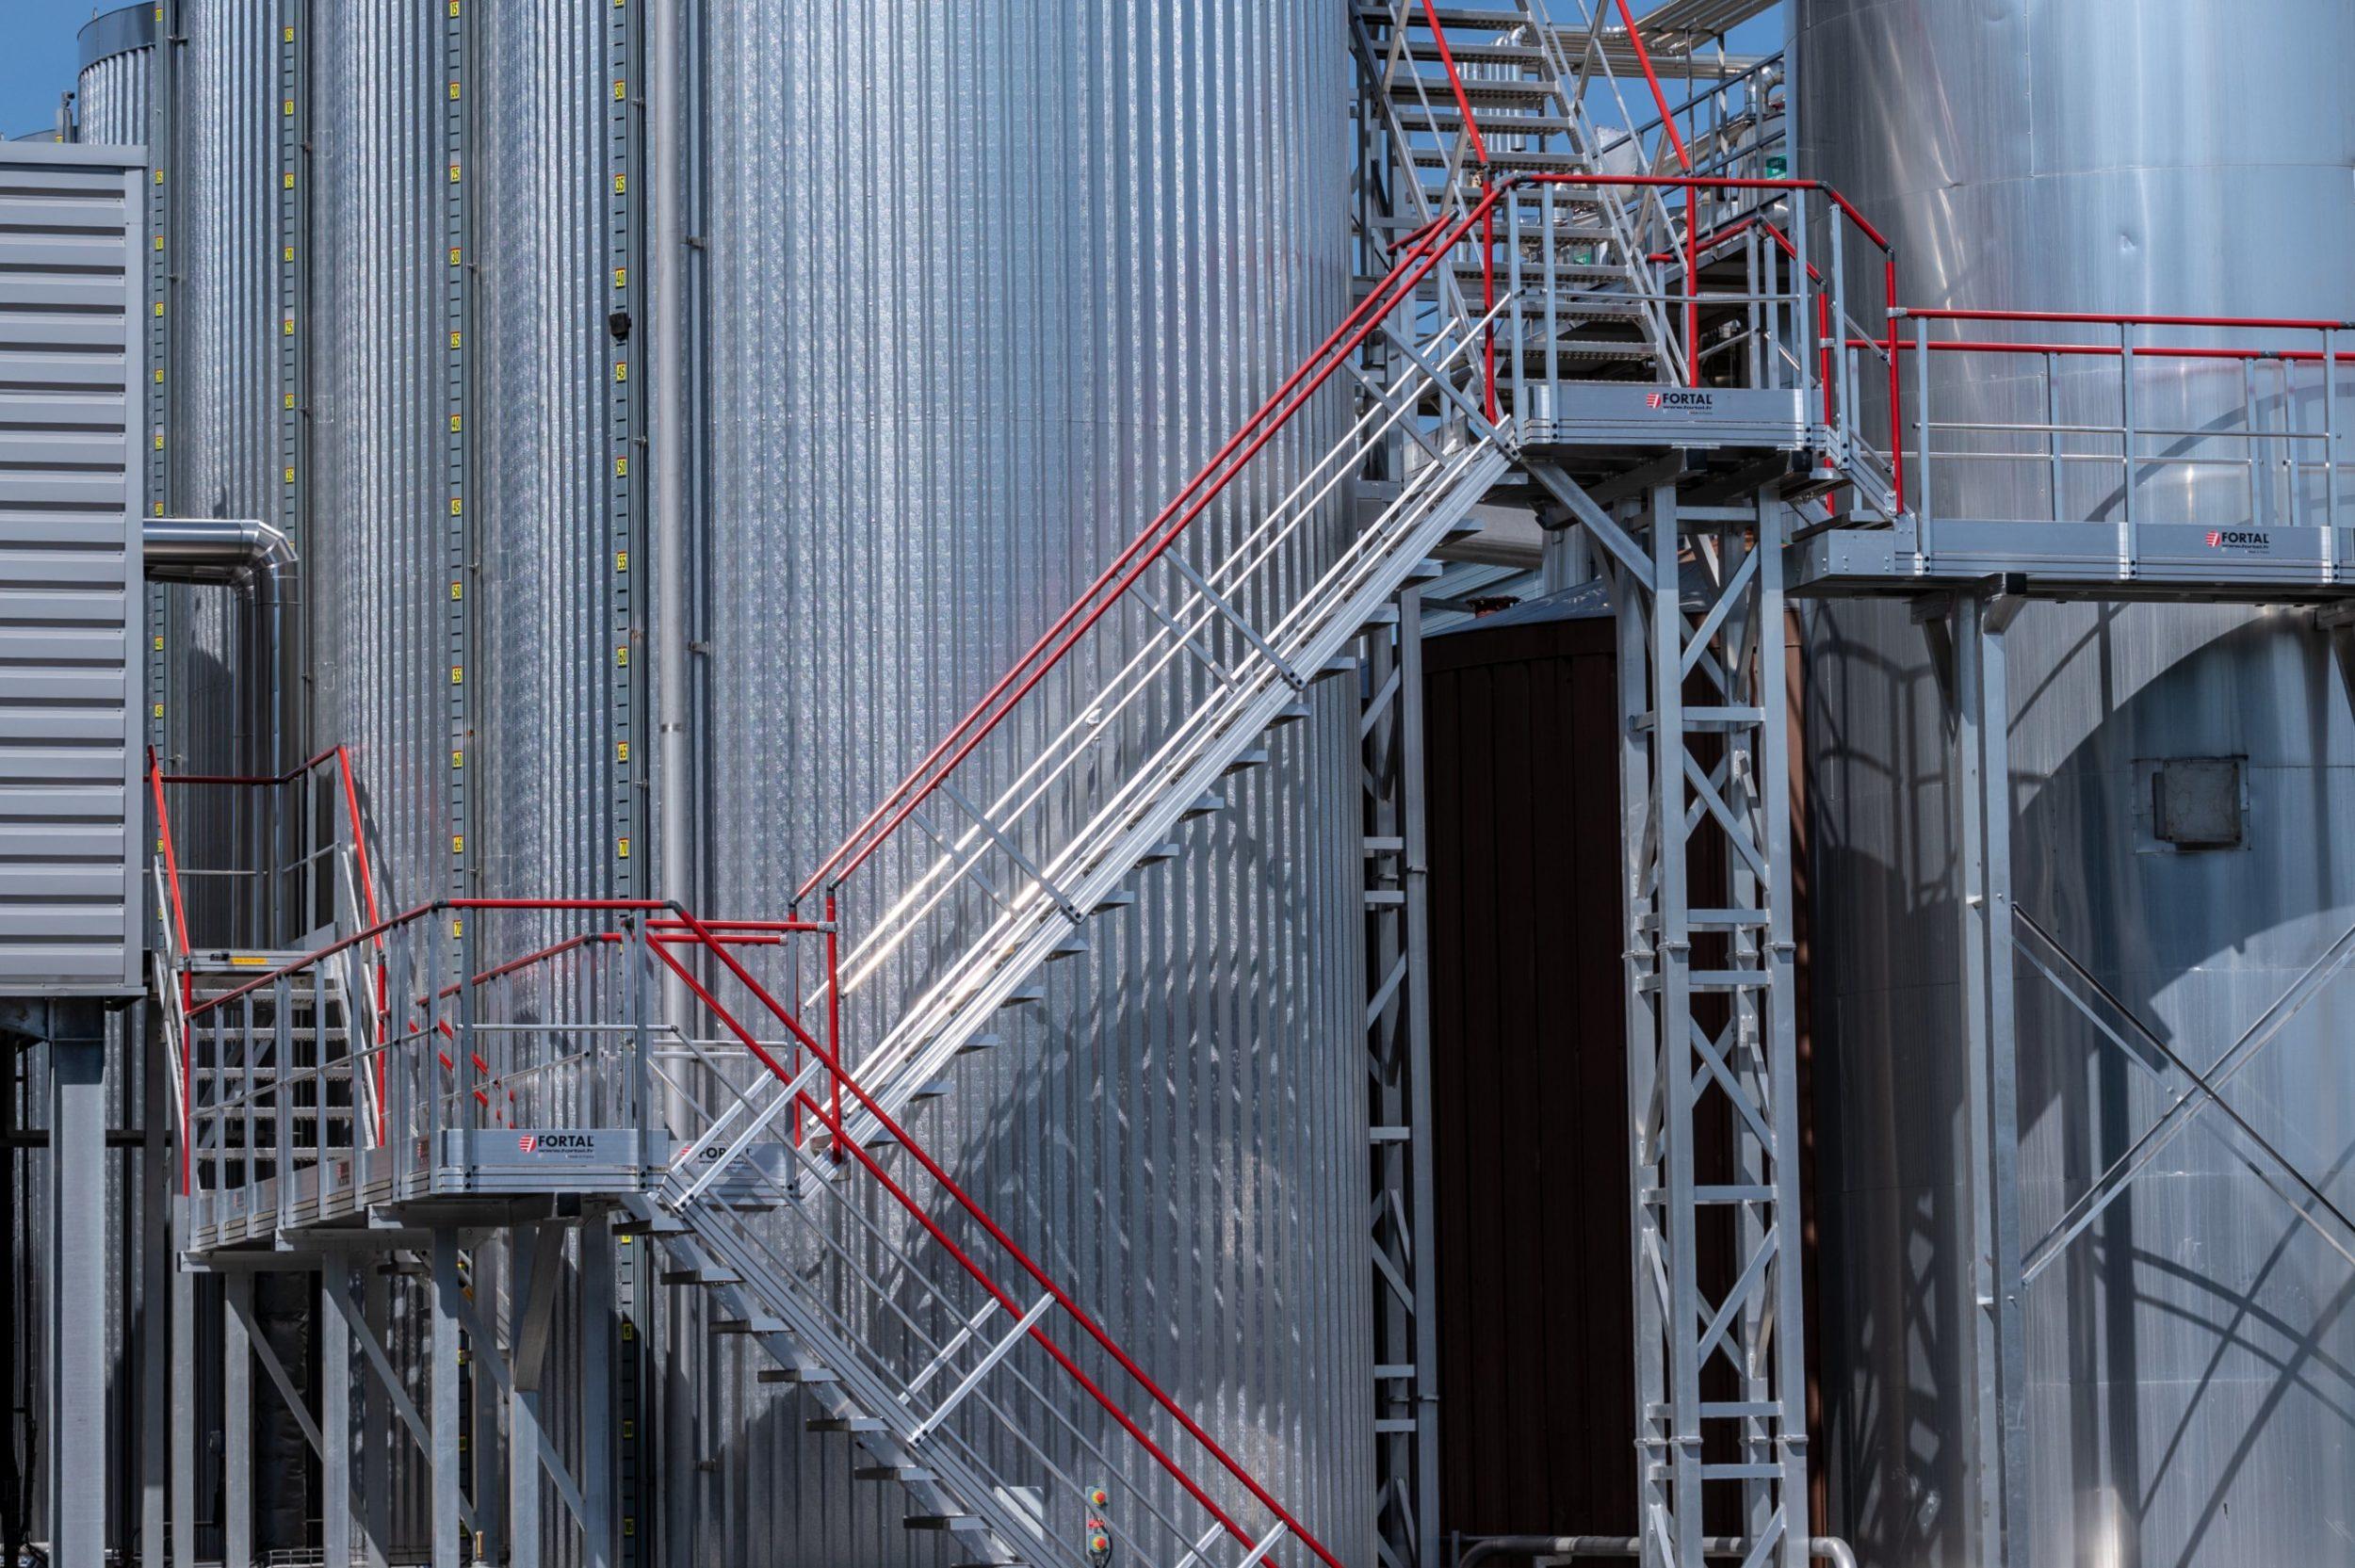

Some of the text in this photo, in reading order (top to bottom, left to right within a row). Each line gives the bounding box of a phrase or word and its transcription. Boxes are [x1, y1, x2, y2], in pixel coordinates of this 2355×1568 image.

[451, 167, 459, 181] 25
[616, 271, 625, 285] 40
[617, 364, 625, 380] 45
[1663, 393, 1712, 405] FORTAL
[618, 461, 626, 475] 50
[2221, 532, 2268, 543] FORTAL
[538, 1135, 593, 1147] FORTAL
